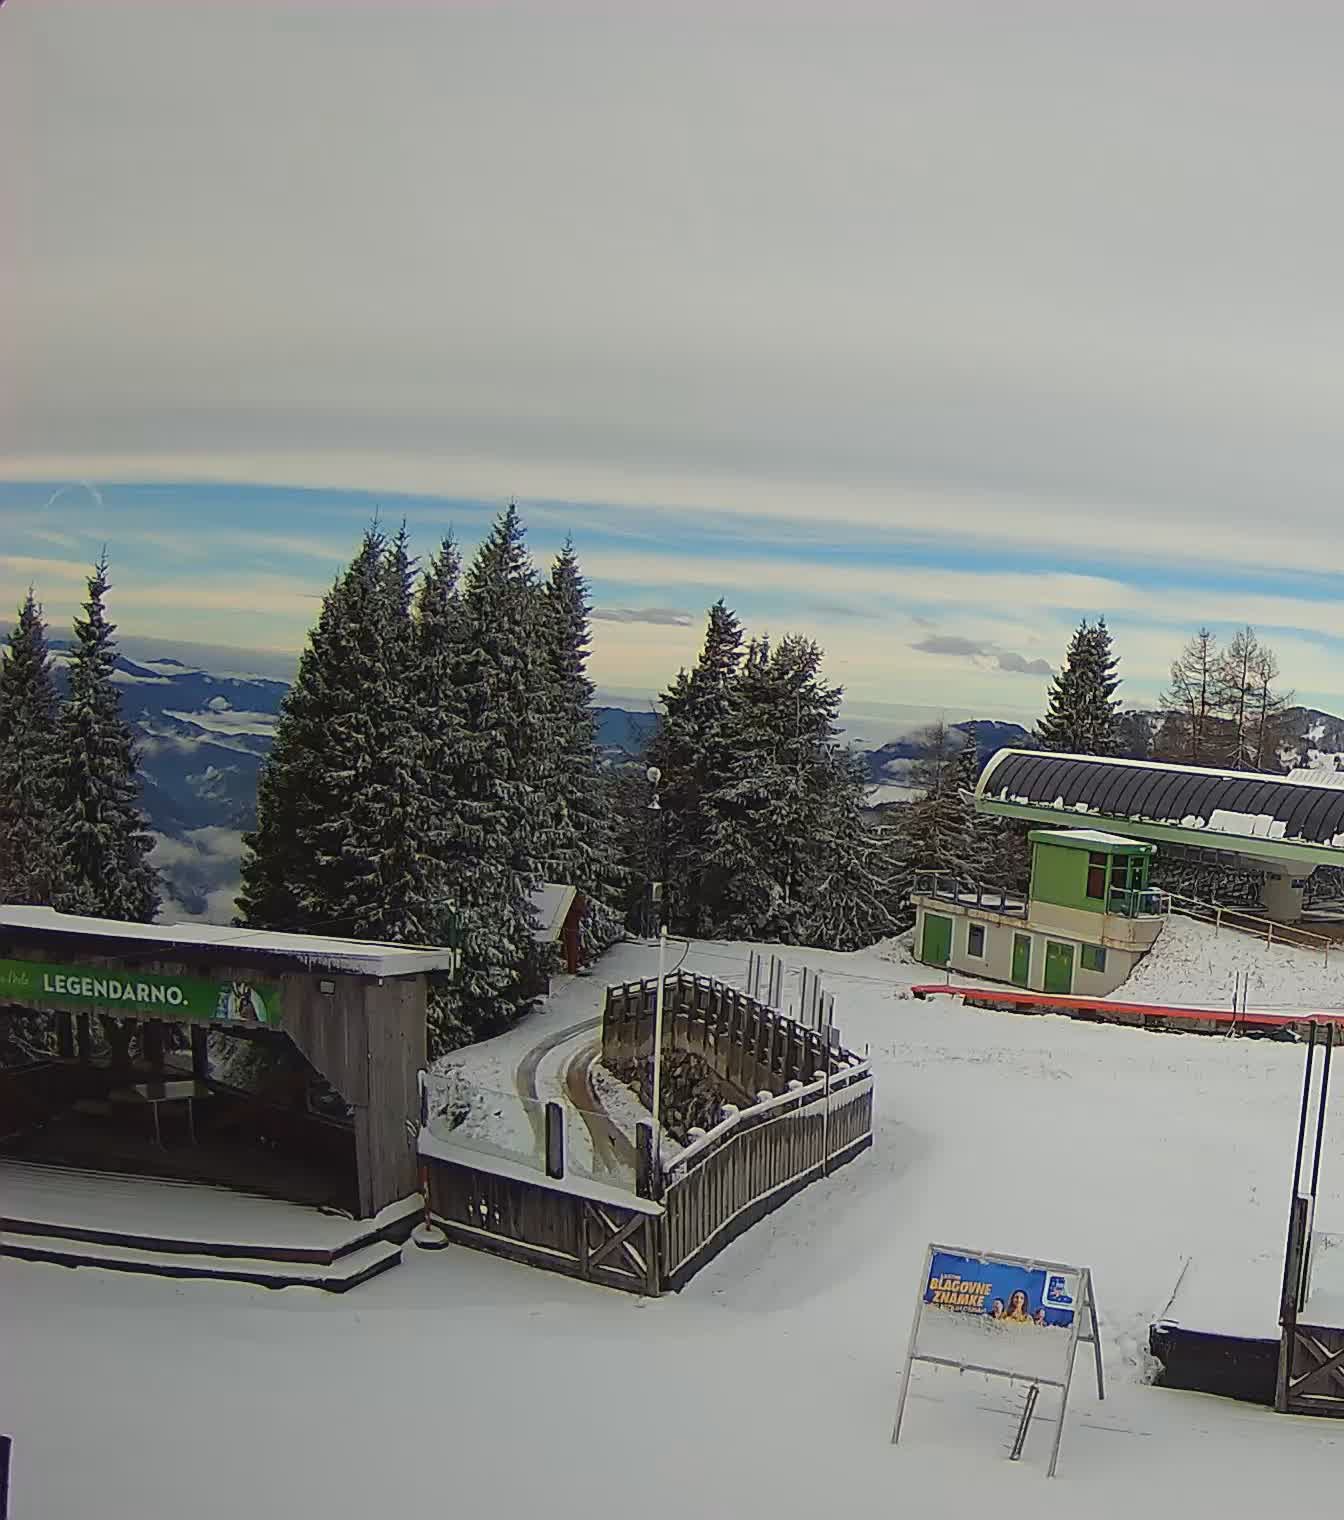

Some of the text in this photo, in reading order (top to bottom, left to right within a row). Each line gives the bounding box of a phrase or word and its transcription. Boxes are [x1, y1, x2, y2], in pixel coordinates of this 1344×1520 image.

[43, 973, 189, 1006] LEGENDARNO.
[929, 1277, 993, 1296] BLAGOVNE
[932, 1290, 985, 1307] ZNAMKE
